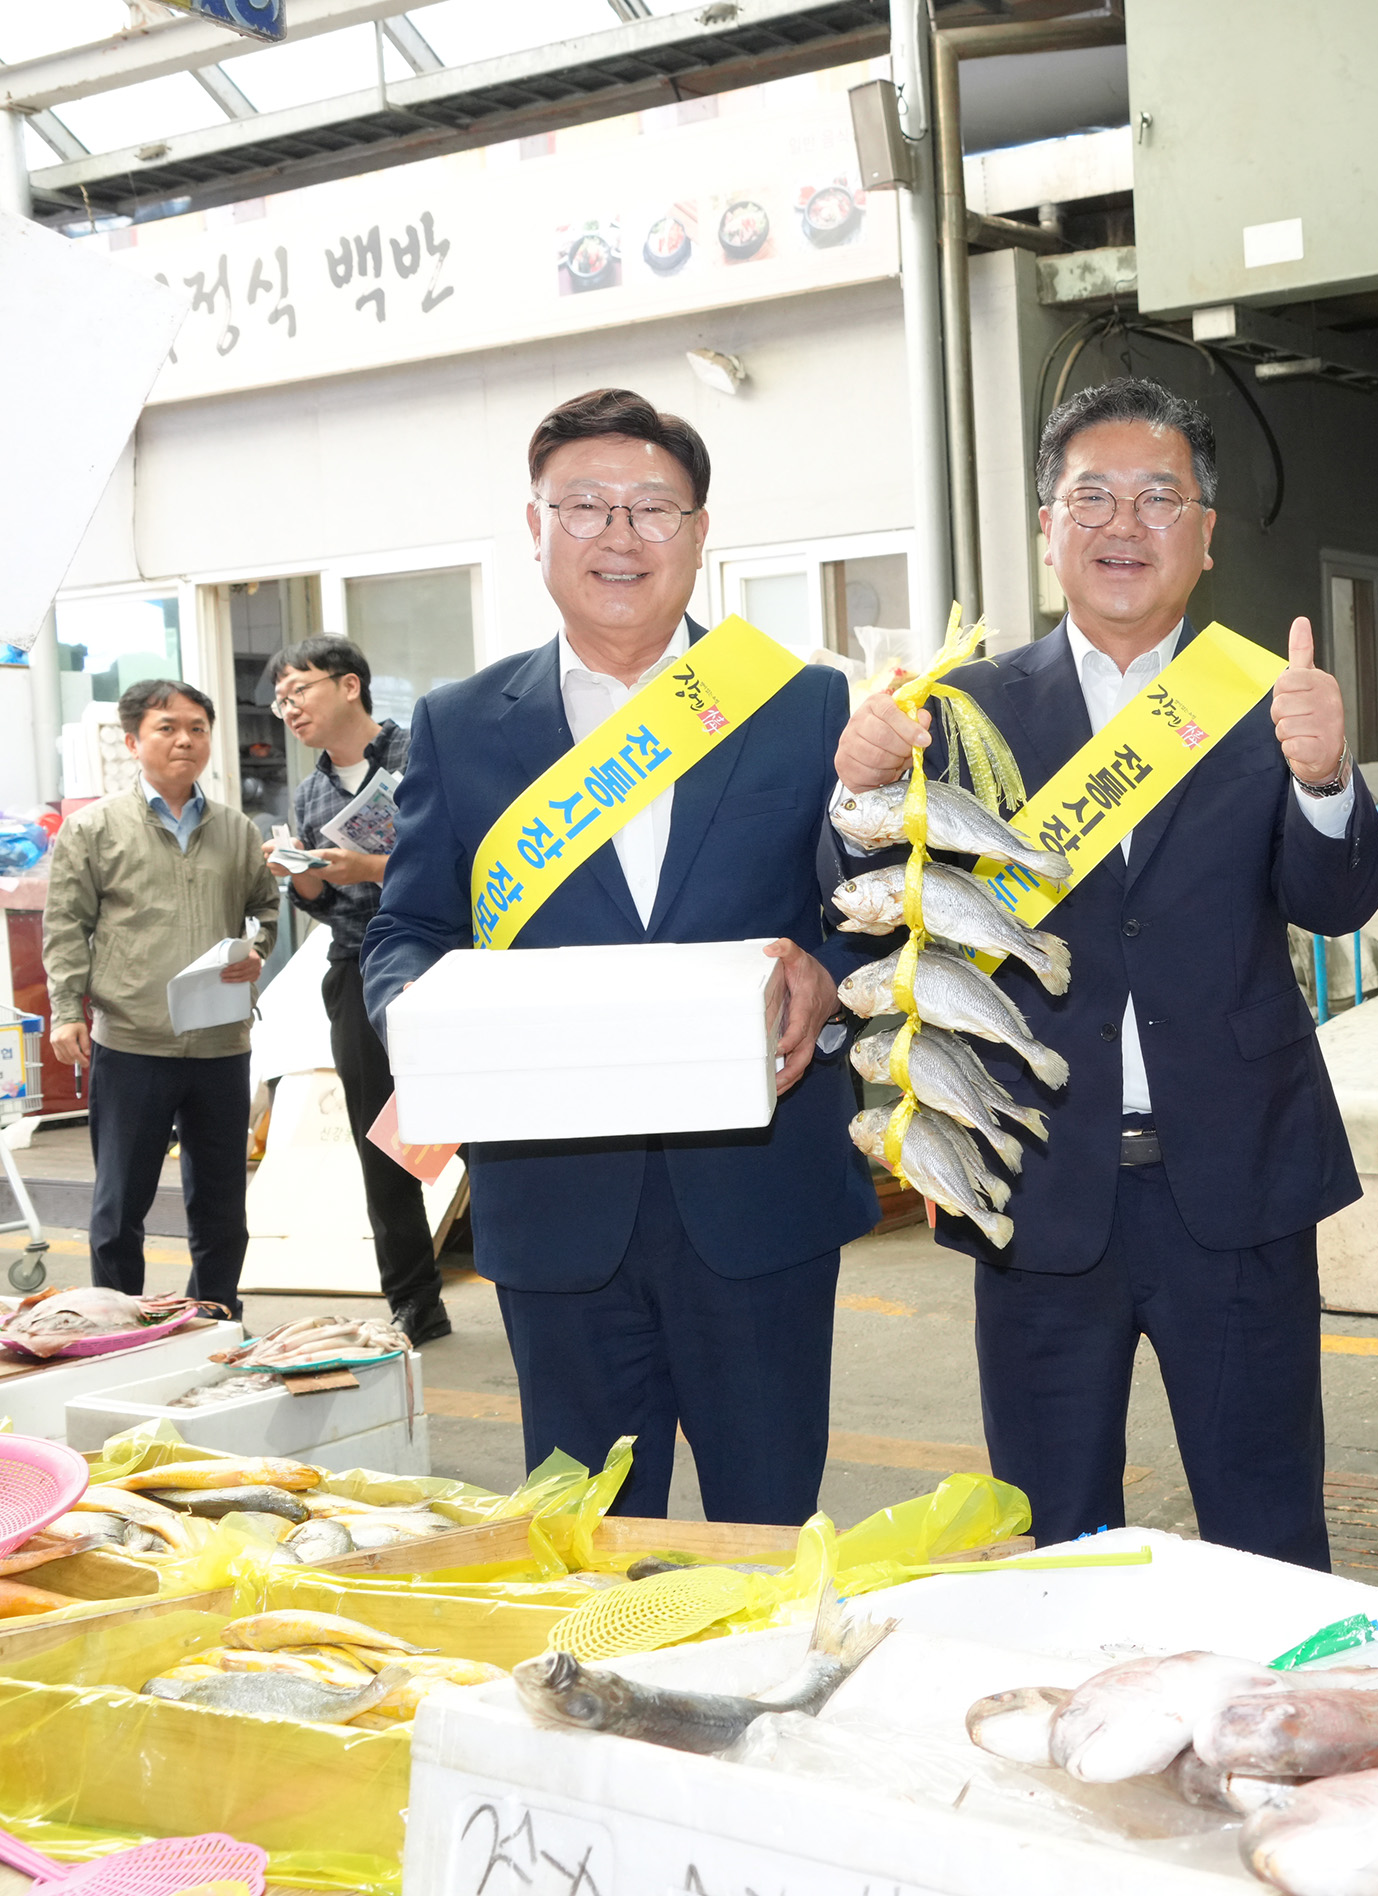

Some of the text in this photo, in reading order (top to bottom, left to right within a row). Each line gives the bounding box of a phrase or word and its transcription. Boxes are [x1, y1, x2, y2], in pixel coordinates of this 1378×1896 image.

[155, 211, 454, 364] 정식 백반
[517, 725, 673, 869] 전통시장
[1039, 744, 1153, 856] 전통시장
